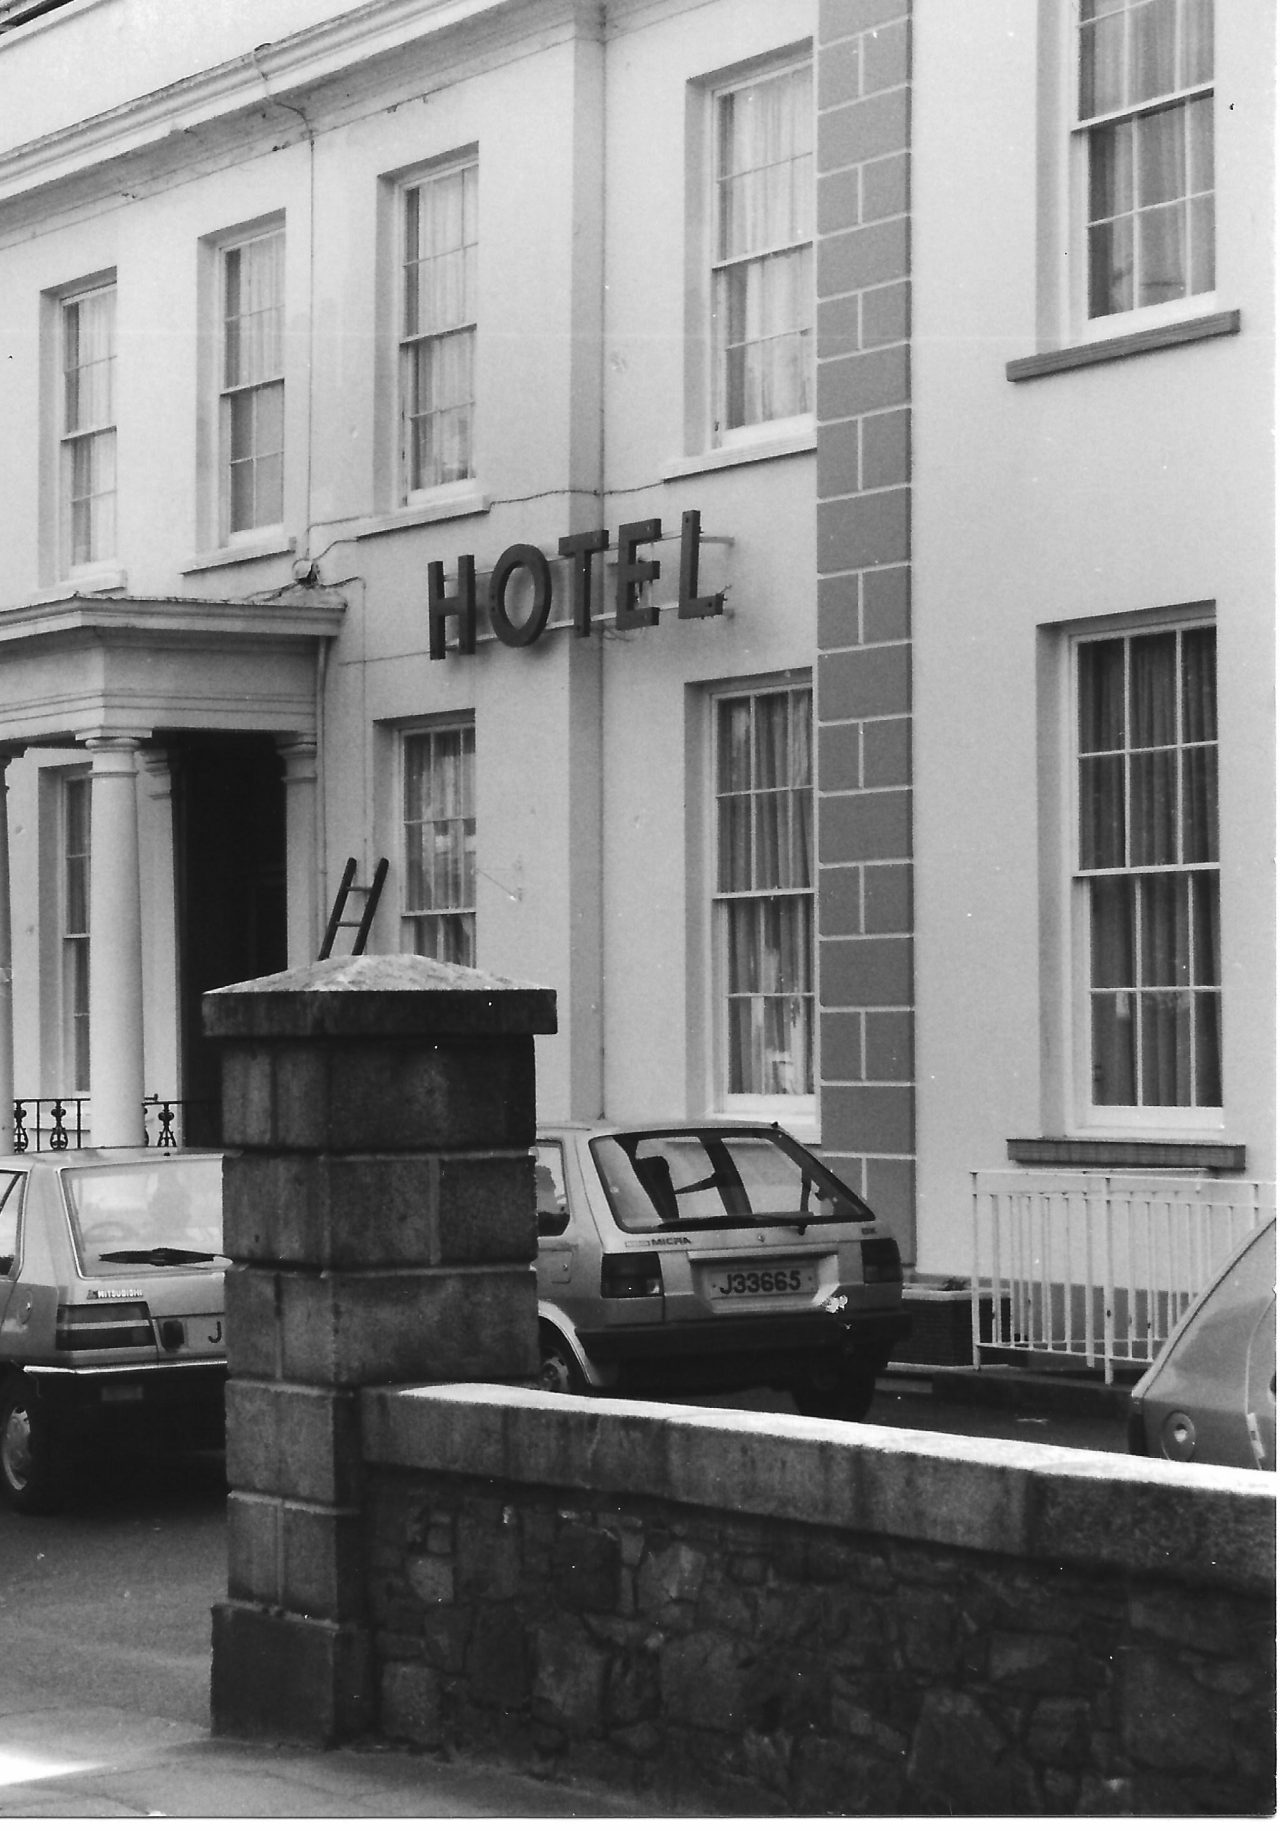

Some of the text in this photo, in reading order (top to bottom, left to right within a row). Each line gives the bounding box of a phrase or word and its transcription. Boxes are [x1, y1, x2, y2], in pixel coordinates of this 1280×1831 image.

[427, 509, 724, 660] HOTEL
[651, 1237, 691, 1246] MICRA
[720, 1270, 801, 1295] J33665
